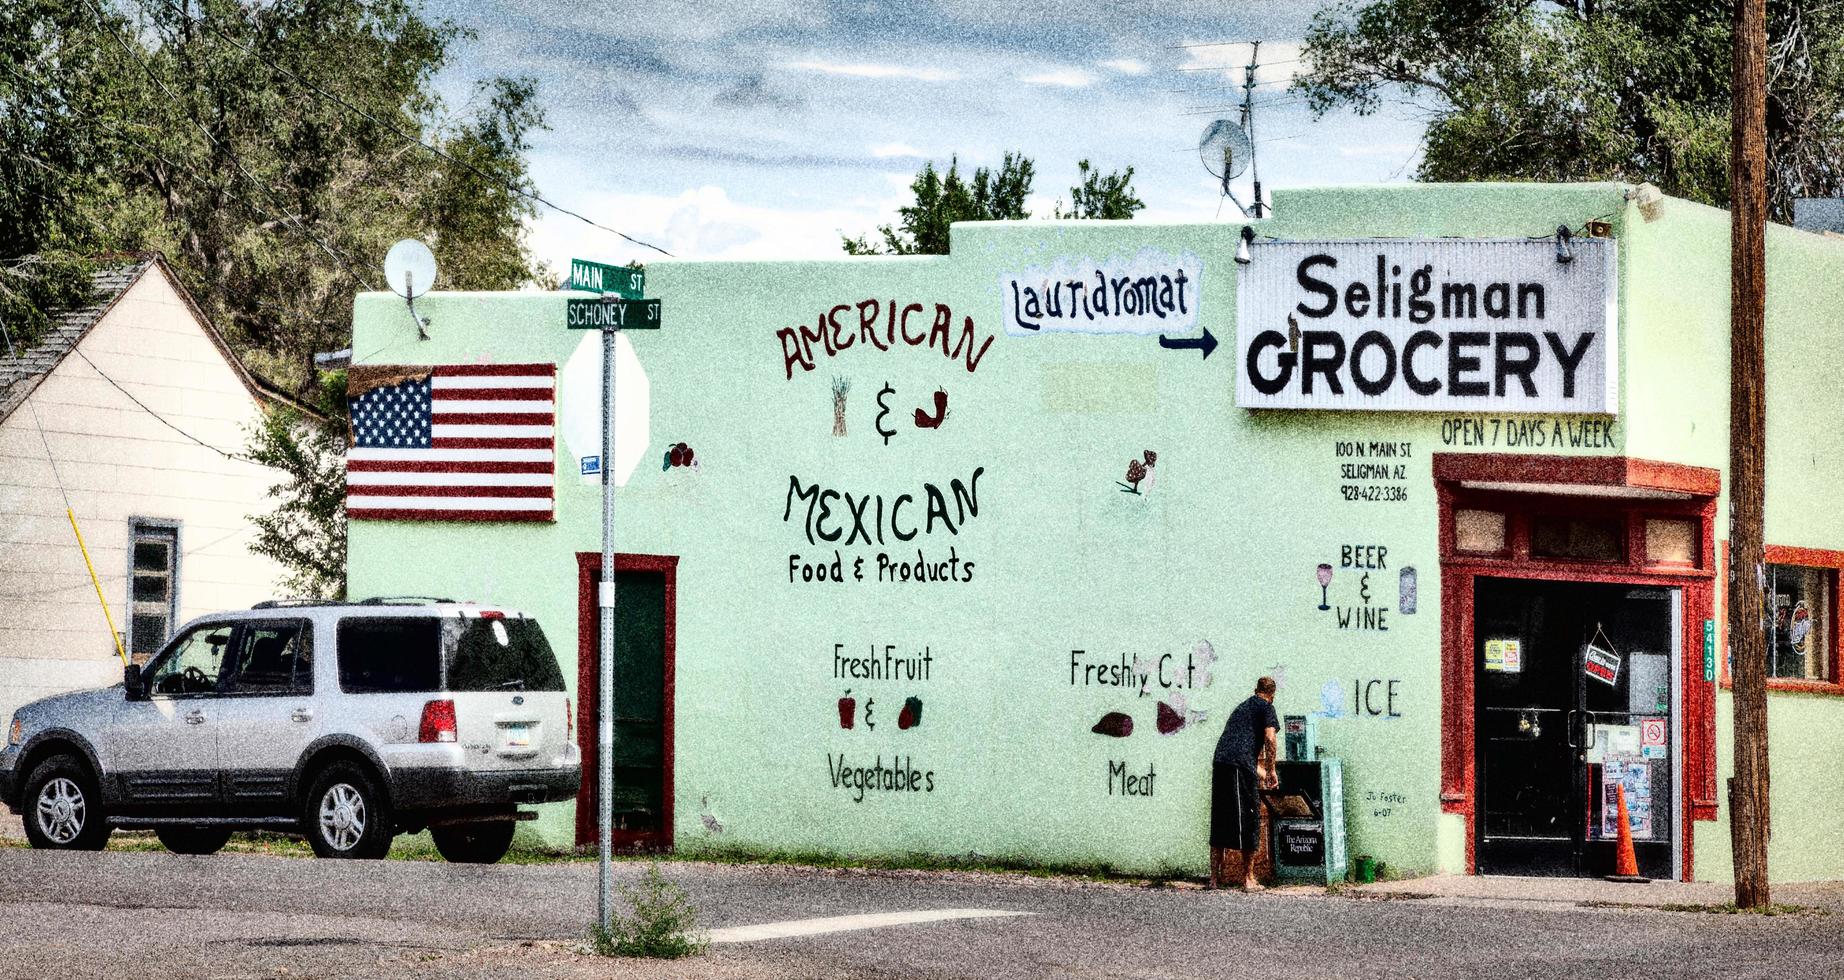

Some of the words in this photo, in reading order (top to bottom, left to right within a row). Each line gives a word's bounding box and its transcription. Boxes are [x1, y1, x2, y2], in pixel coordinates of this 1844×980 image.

[573, 263, 603, 290] MAIN
[630, 273, 643, 291] ST
[1296, 254, 1545, 324] Seligman
[568, 303, 627, 325] SCHONEY
[647, 303, 660, 320] ST
[1011, 268, 1189, 330] Laundromat
[776, 299, 995, 380] AMERICAN
[1246, 329, 1596, 398] GROCERY
[1335, 442, 1354, 457] 100
[1369, 442, 1397, 457] MAIN
[1441, 418, 1484, 446] OPEN
[1490, 419, 1501, 446] 7
[1506, 419, 1547, 447] DAYS
[1551, 419, 1564, 448] A
[1567, 420, 1616, 448] WEEK
[783, 467, 985, 546] MEXICAN
[789, 550, 844, 583] Food
[853, 555, 865, 582] &
[876, 546, 976, 582] Products
[1341, 544, 1388, 569] BEER
[1337, 606, 1389, 631] WINE
[834, 643, 881, 680] Fresh
[885, 645, 933, 681] Fruit
[1704, 619, 1714, 680] 54130
[1158, 652, 1195, 689] Ct
[1355, 679, 1402, 717] ICE
[828, 753, 934, 803] Vegetables
[1109, 760, 1157, 797] Meat
[1286, 834, 1295, 844] The
[1295, 834, 1317, 844] Arizona
[1290, 843, 1313, 854] Republic
